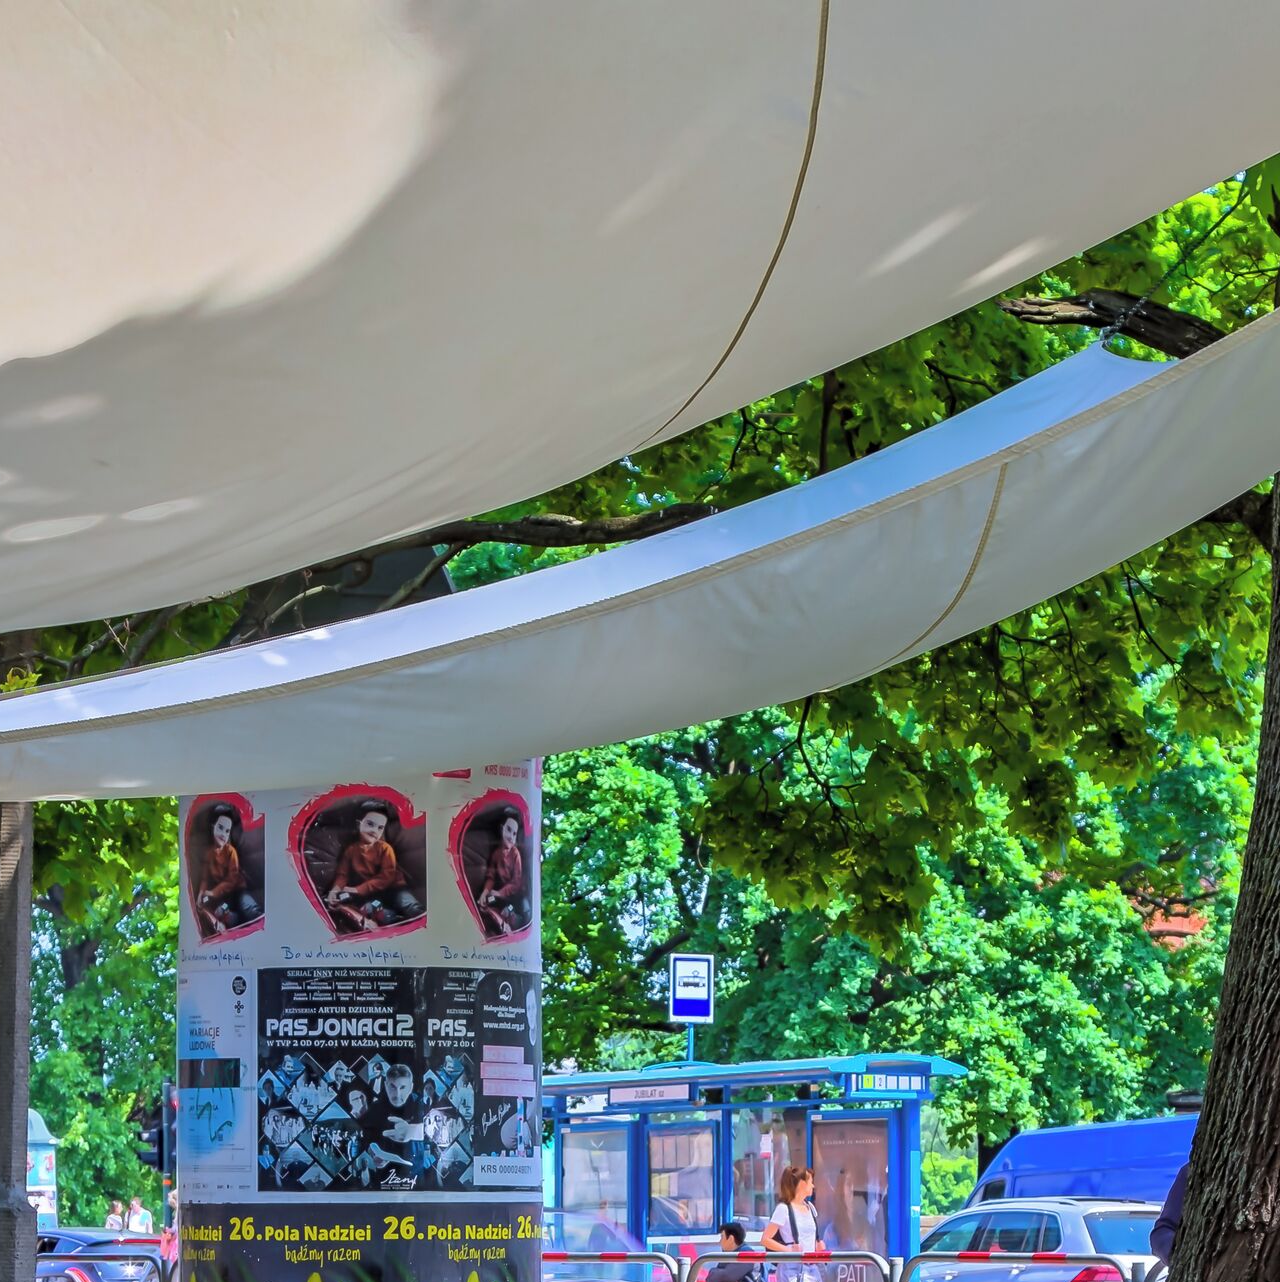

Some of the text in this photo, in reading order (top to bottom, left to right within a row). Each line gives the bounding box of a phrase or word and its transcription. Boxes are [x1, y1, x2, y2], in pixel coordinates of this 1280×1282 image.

[484, 764, 498, 776] KRS
[281, 946, 300, 960] Bo
[440, 945, 458, 960] Bo
[314, 969, 333, 977] INNY
[335, 968, 348, 976] NIŻ
[318, 1006, 346, 1014] ARTUR
[349, 1006, 393, 1014] DZIURMAN
[266, 1018, 393, 1036] PASJONACI
[396, 1014, 414, 1036] 2
[189, 1026, 220, 1039] WARIACJE
[188, 1040, 216, 1051] LUDOWE
[314, 1040, 338, 1048] 07.01
[352, 1038, 379, 1048] KAŻDĄ
[634, 1088, 657, 1099] JUBILAT
[480, 1164, 497, 1174] KRS
[189, 1224, 222, 1242] Nadziei
[229, 1216, 372, 1242] 26. Pola Nadziei
[383, 1216, 512, 1240] 26. Pola Nadziei
[516, 1215, 534, 1239] 26.
[284, 1244, 361, 1268] bądźmy razem
[448, 1244, 506, 1266] bądźmy razem
